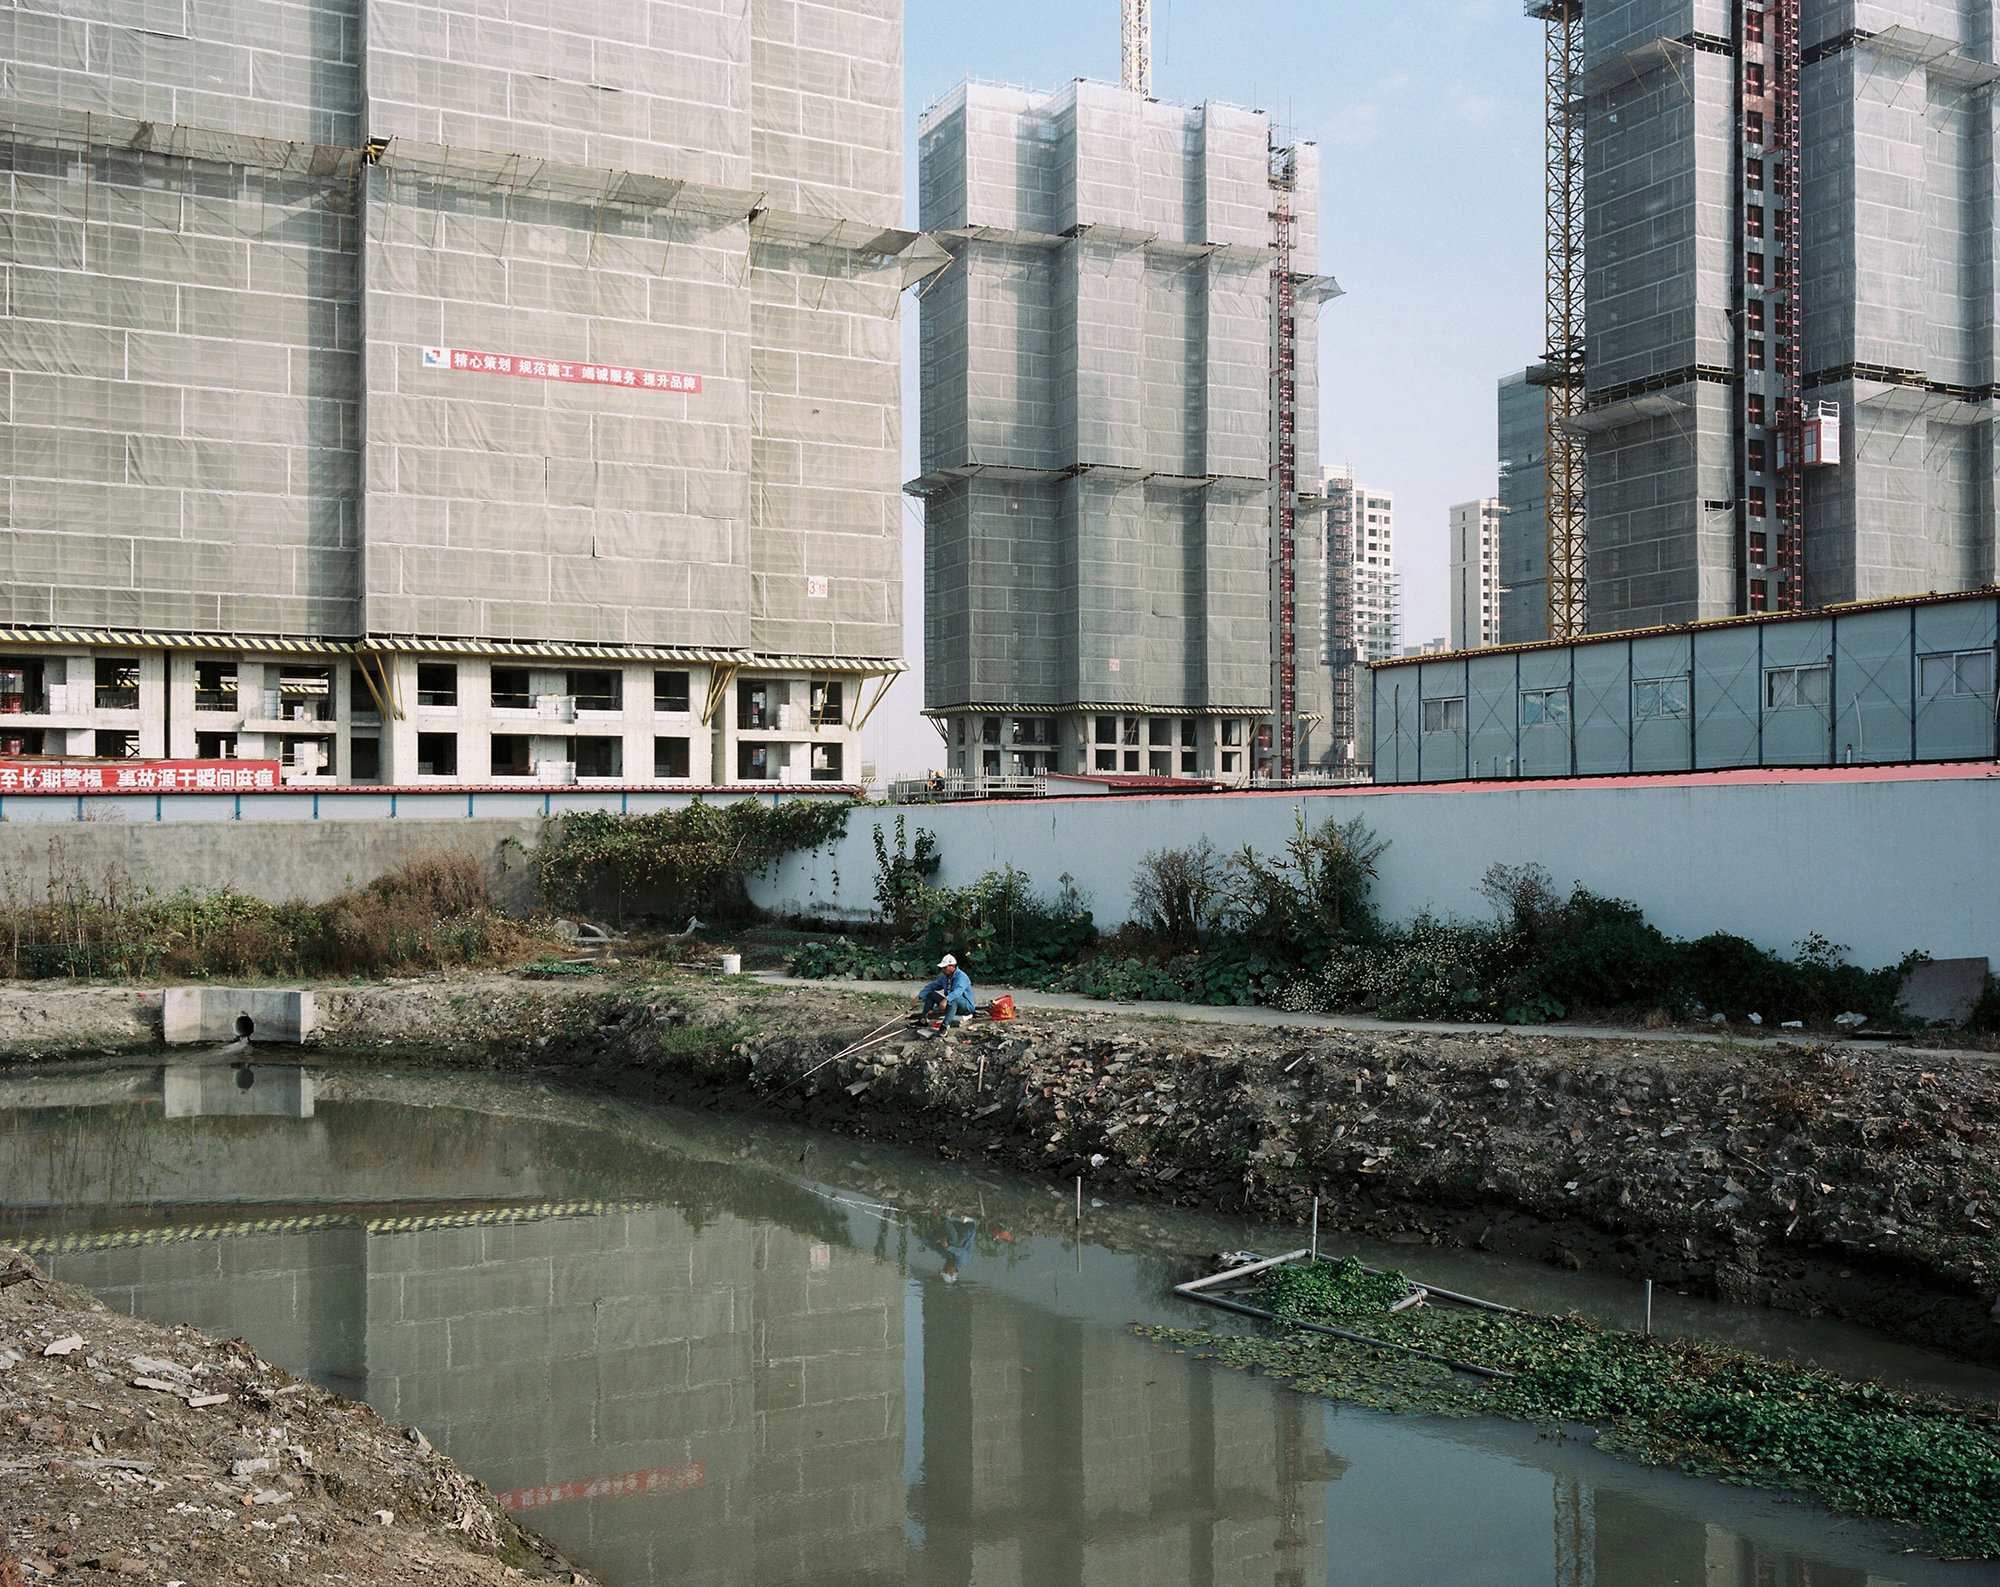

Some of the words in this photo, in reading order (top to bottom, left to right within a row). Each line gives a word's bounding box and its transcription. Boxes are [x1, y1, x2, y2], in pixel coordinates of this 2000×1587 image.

[454, 352, 511, 372] 精心策划
[518, 359, 574, 378] 规范施工
[581, 366, 636, 385] 竭诚服务
[643, 372, 696, 390] 提升品牌
